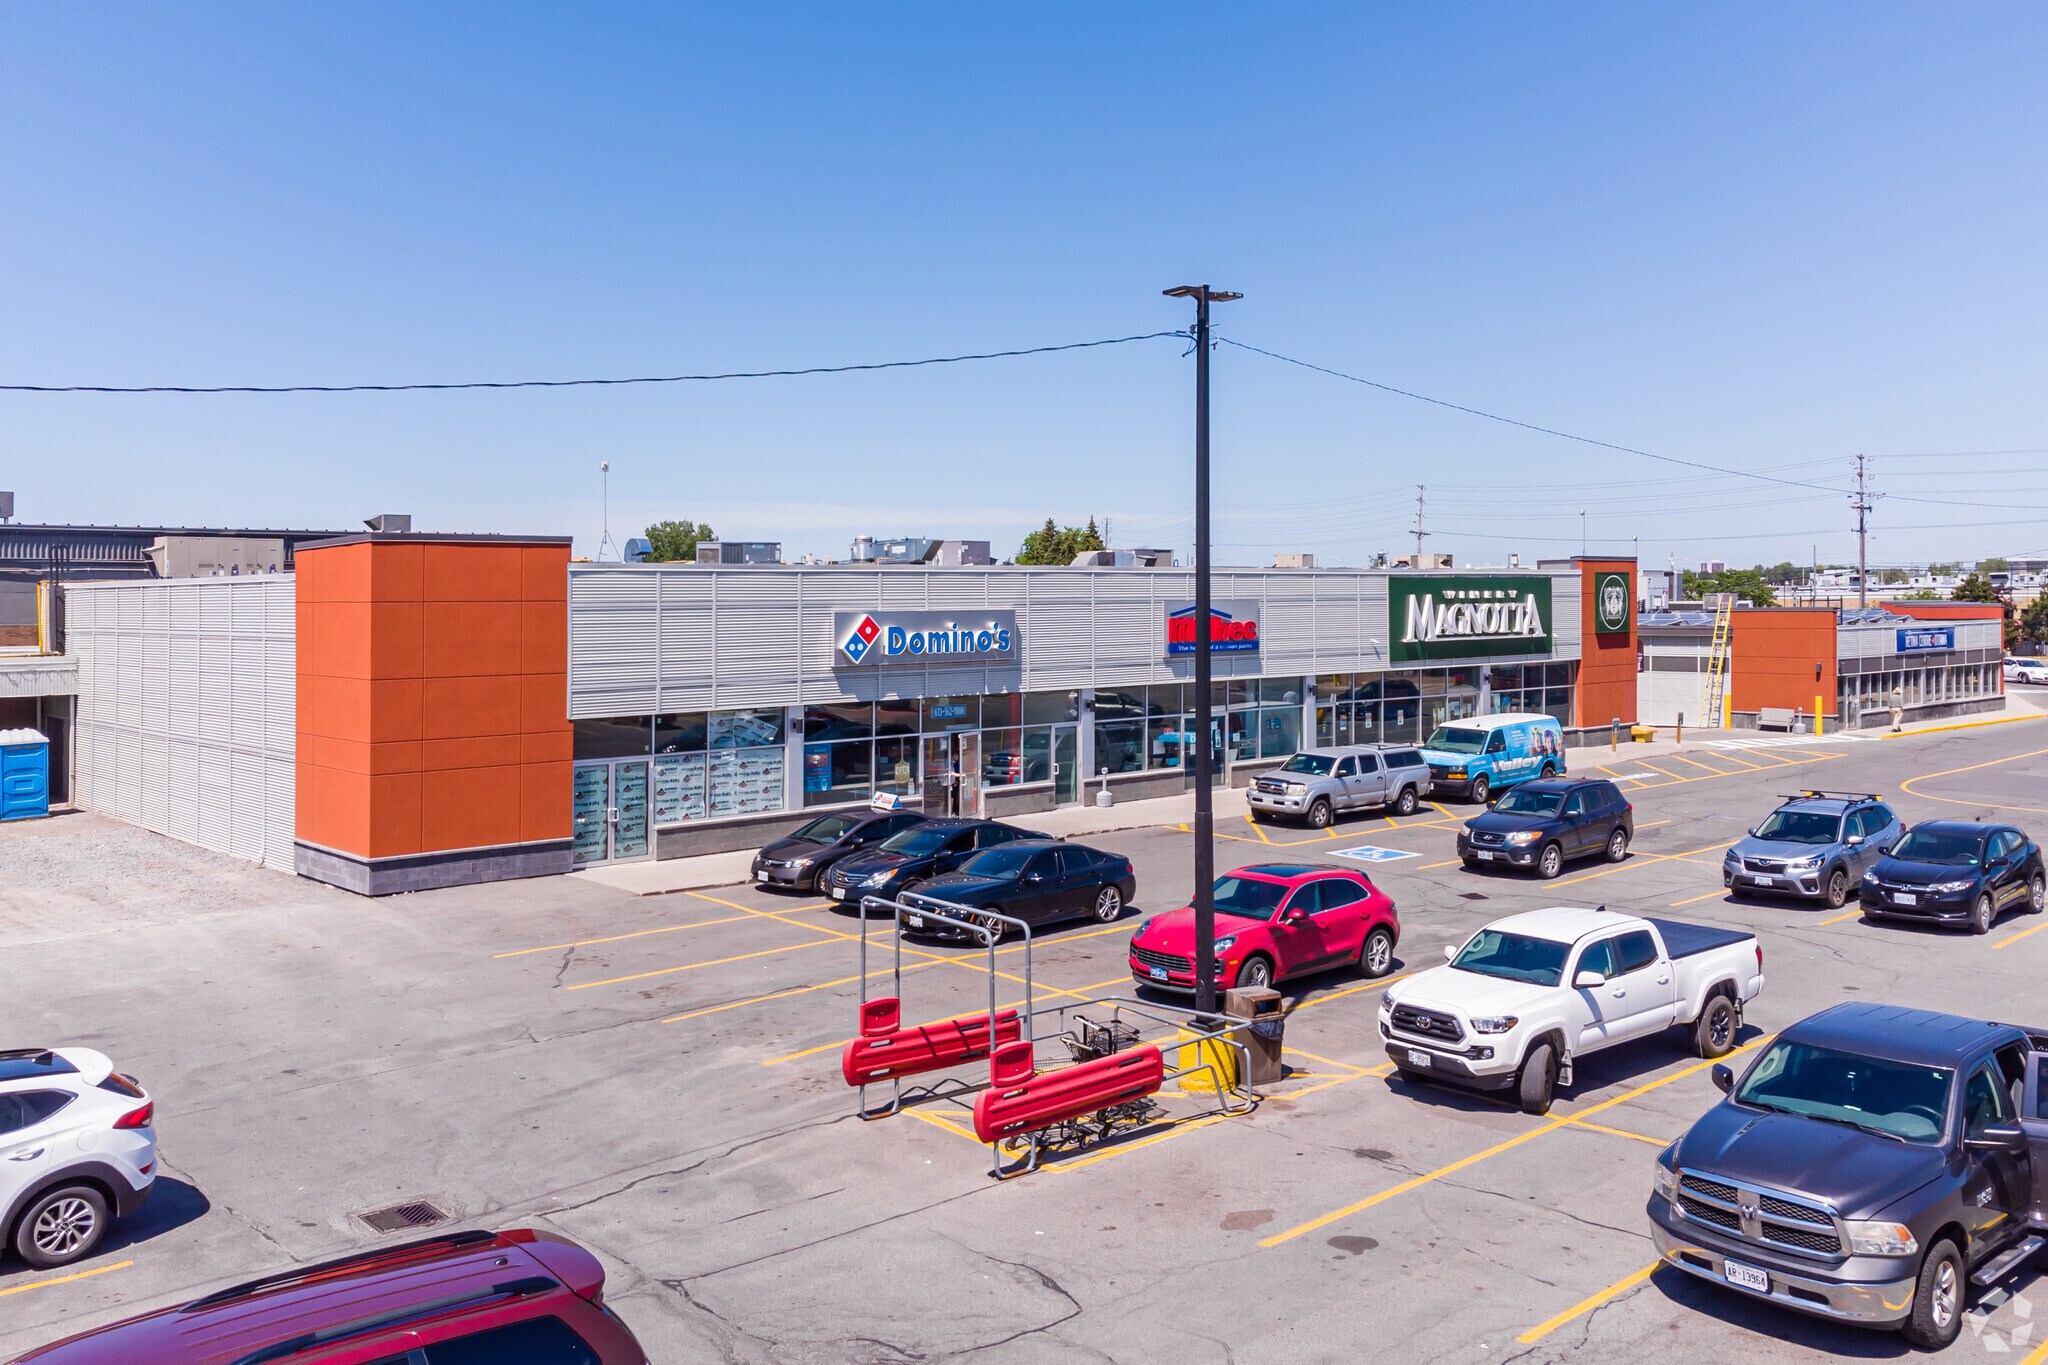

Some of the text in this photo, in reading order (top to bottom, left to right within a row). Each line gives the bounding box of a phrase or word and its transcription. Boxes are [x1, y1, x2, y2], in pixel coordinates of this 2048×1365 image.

[1442, 590, 1518, 599] WINERY
[1401, 593, 1547, 643] MAGNOTTA
[885, 622, 1011, 656] Domino's
[1492, 755, 1543, 773] Valley
